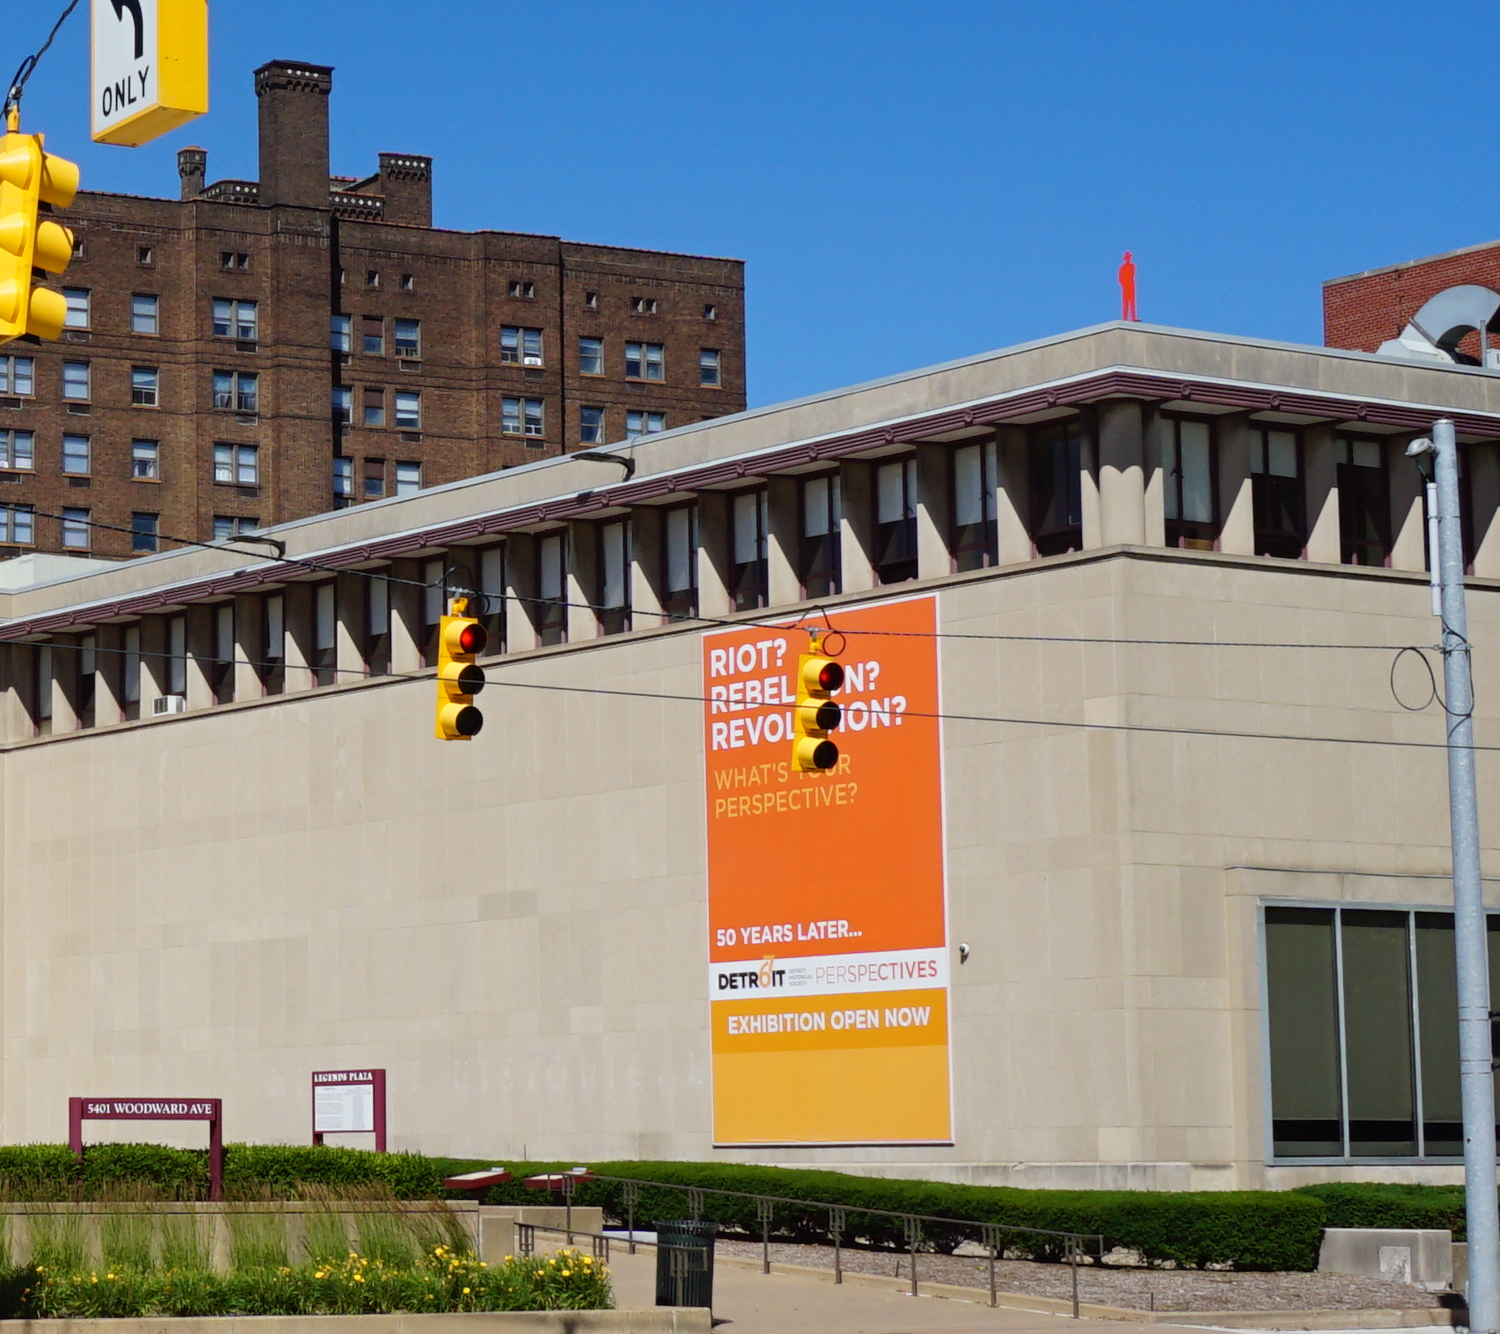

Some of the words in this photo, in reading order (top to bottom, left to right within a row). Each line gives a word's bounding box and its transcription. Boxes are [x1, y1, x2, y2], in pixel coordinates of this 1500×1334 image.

[102, 65, 149, 117] ONLY
[710, 637, 787, 678] RIOT?
[711, 660, 880, 715] REBELN?
[711, 695, 907, 751] REVOLION?
[714, 762, 789, 791] WHAT'S
[715, 782, 858, 819] PERSPECTIVE?
[716, 928, 736, 947] 50
[740, 923, 793, 945] YEARS
[797, 919, 862, 941] LATER...
[815, 960, 938, 984] PERSPECTIVES
[728, 1011, 826, 1035] EXHIBITION
[830, 1009, 879, 1030] OPEN
[884, 1006, 931, 1028] NOW
[314, 1073, 347, 1082] LEGENDS
[349, 1072, 373, 1081] PLAZA
[87, 1103, 111, 1114] 5401
[113, 1103, 187, 1114] WOODWARD
[189, 1103, 212, 1114] AVE
